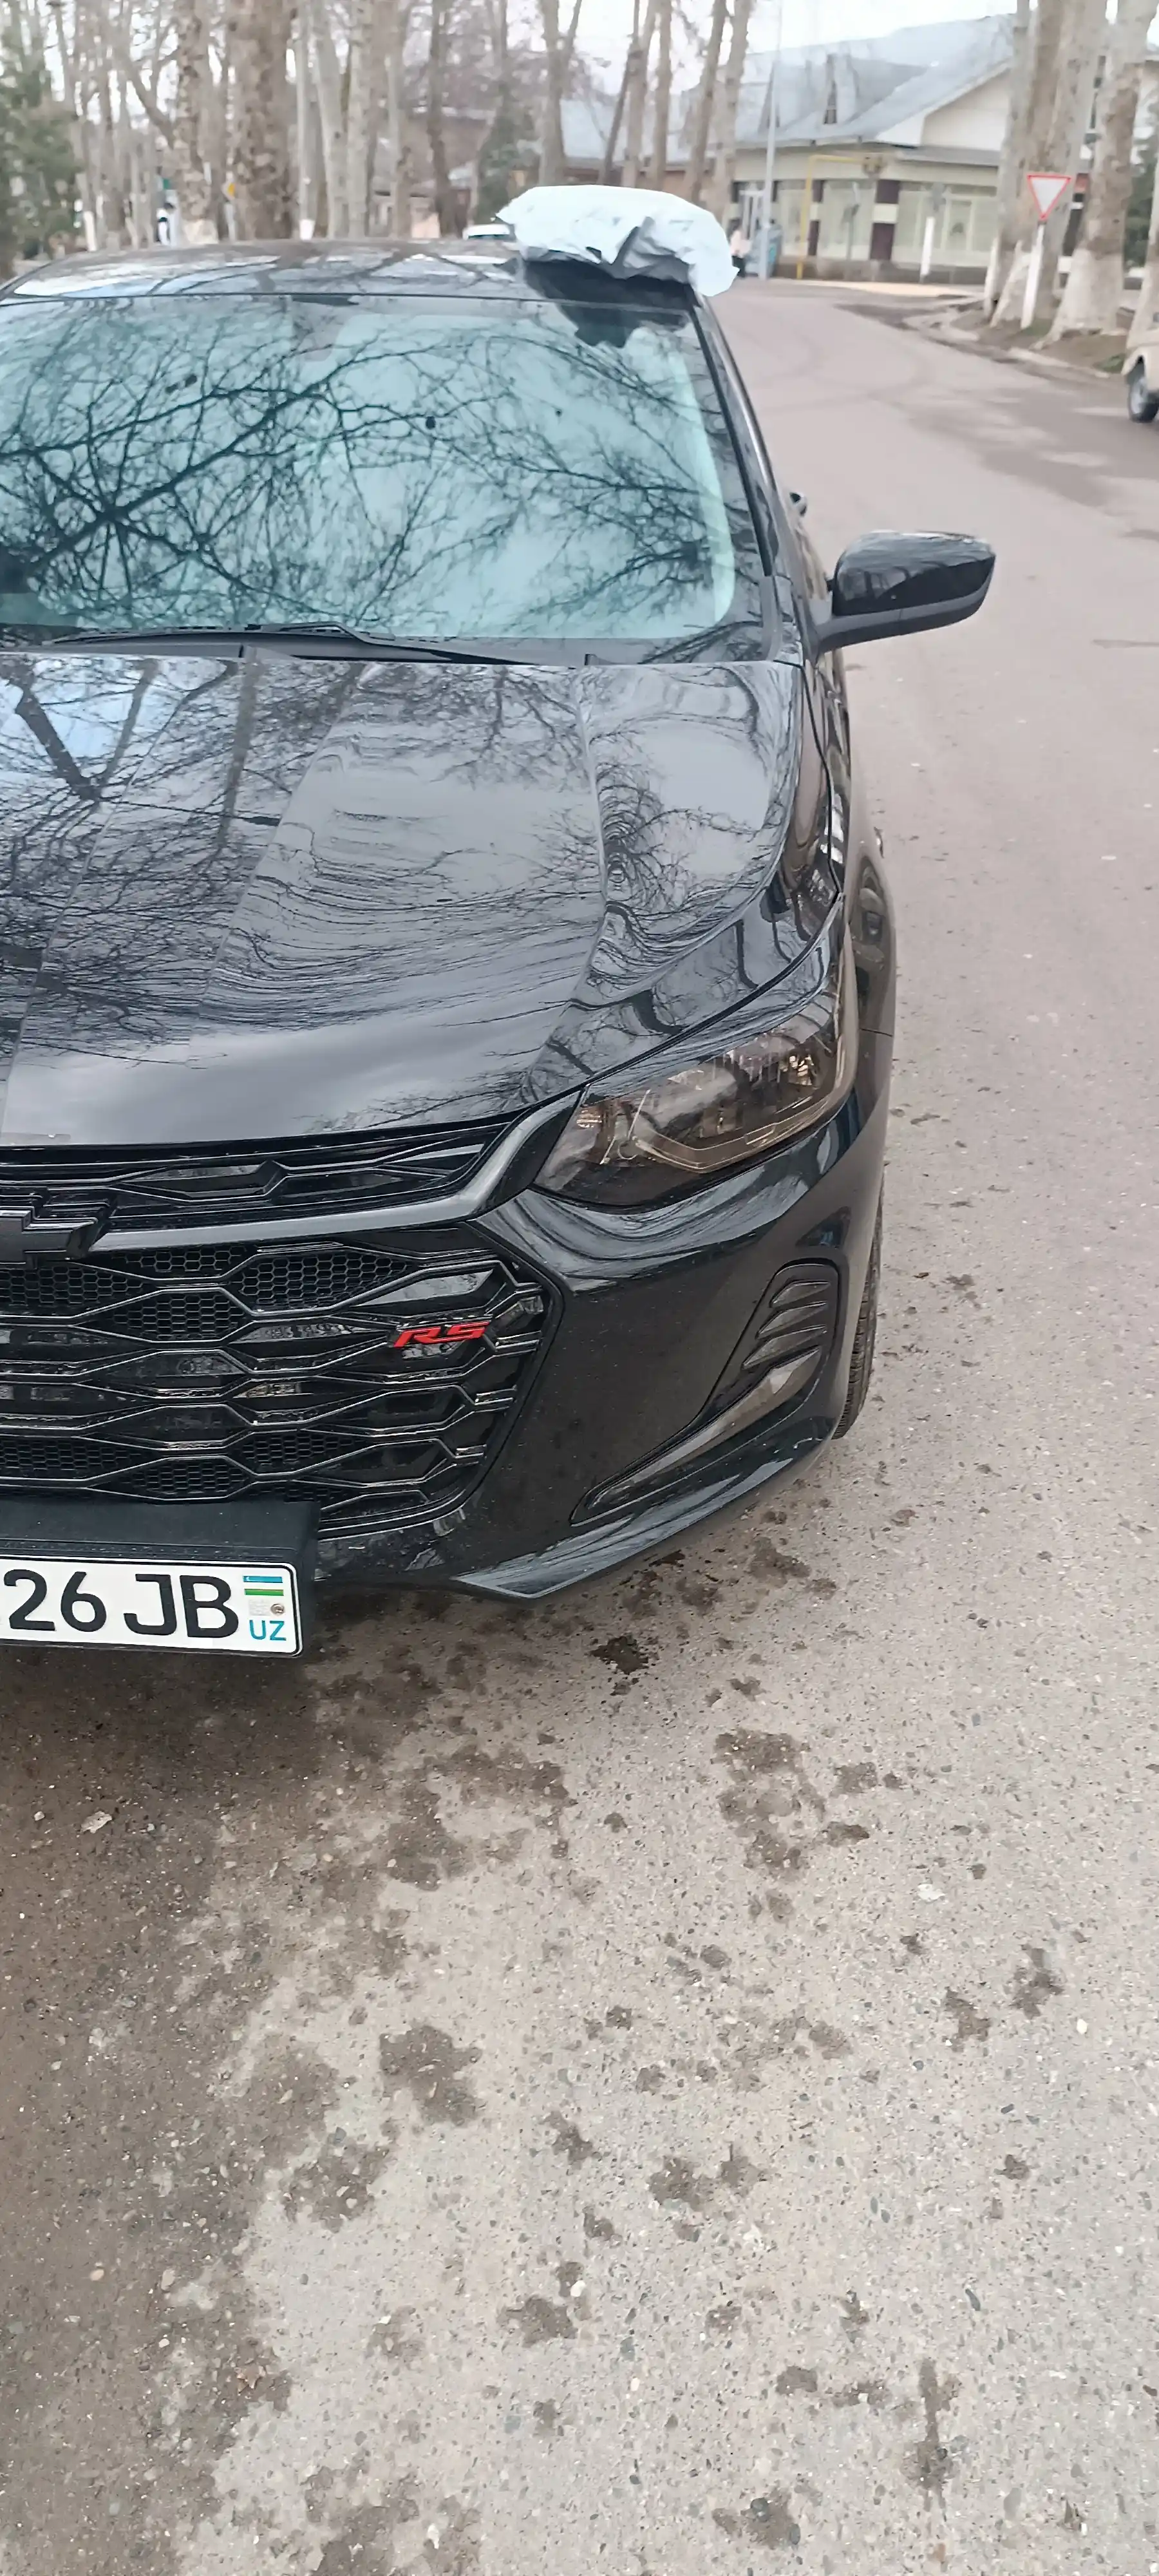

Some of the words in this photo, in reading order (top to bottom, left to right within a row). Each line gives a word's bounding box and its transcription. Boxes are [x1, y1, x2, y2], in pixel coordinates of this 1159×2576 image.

[393, 1321, 491, 1348] RS
[4, 1569, 107, 1632] 26
[124, 1574, 239, 1638] JB
[249, 1620, 287, 1641] UZ
